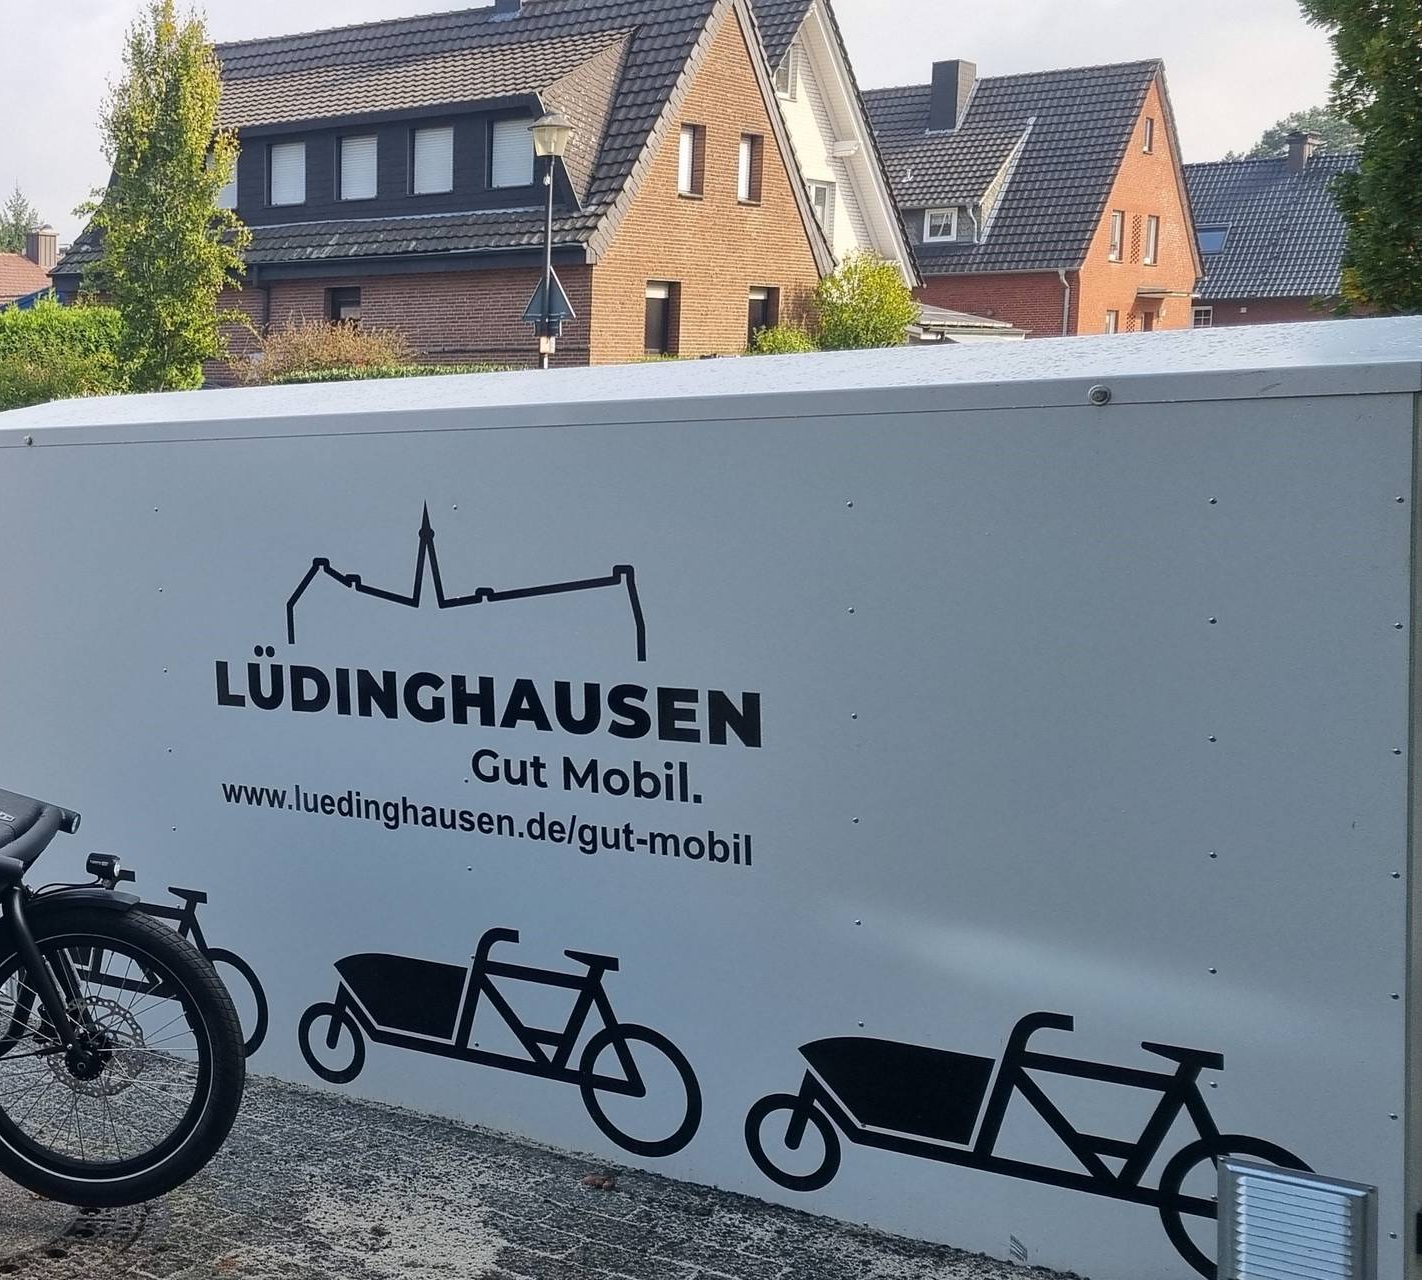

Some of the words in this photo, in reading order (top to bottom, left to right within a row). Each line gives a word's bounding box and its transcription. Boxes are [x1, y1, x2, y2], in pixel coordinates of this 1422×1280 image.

[215, 645, 762, 748] LÜDINGHAUSEN
[471, 748, 549, 789] Gut
[562, 756, 702, 804] Mobil.
[221, 783, 752, 866] www.luedinghausen.de/gut-mobil
